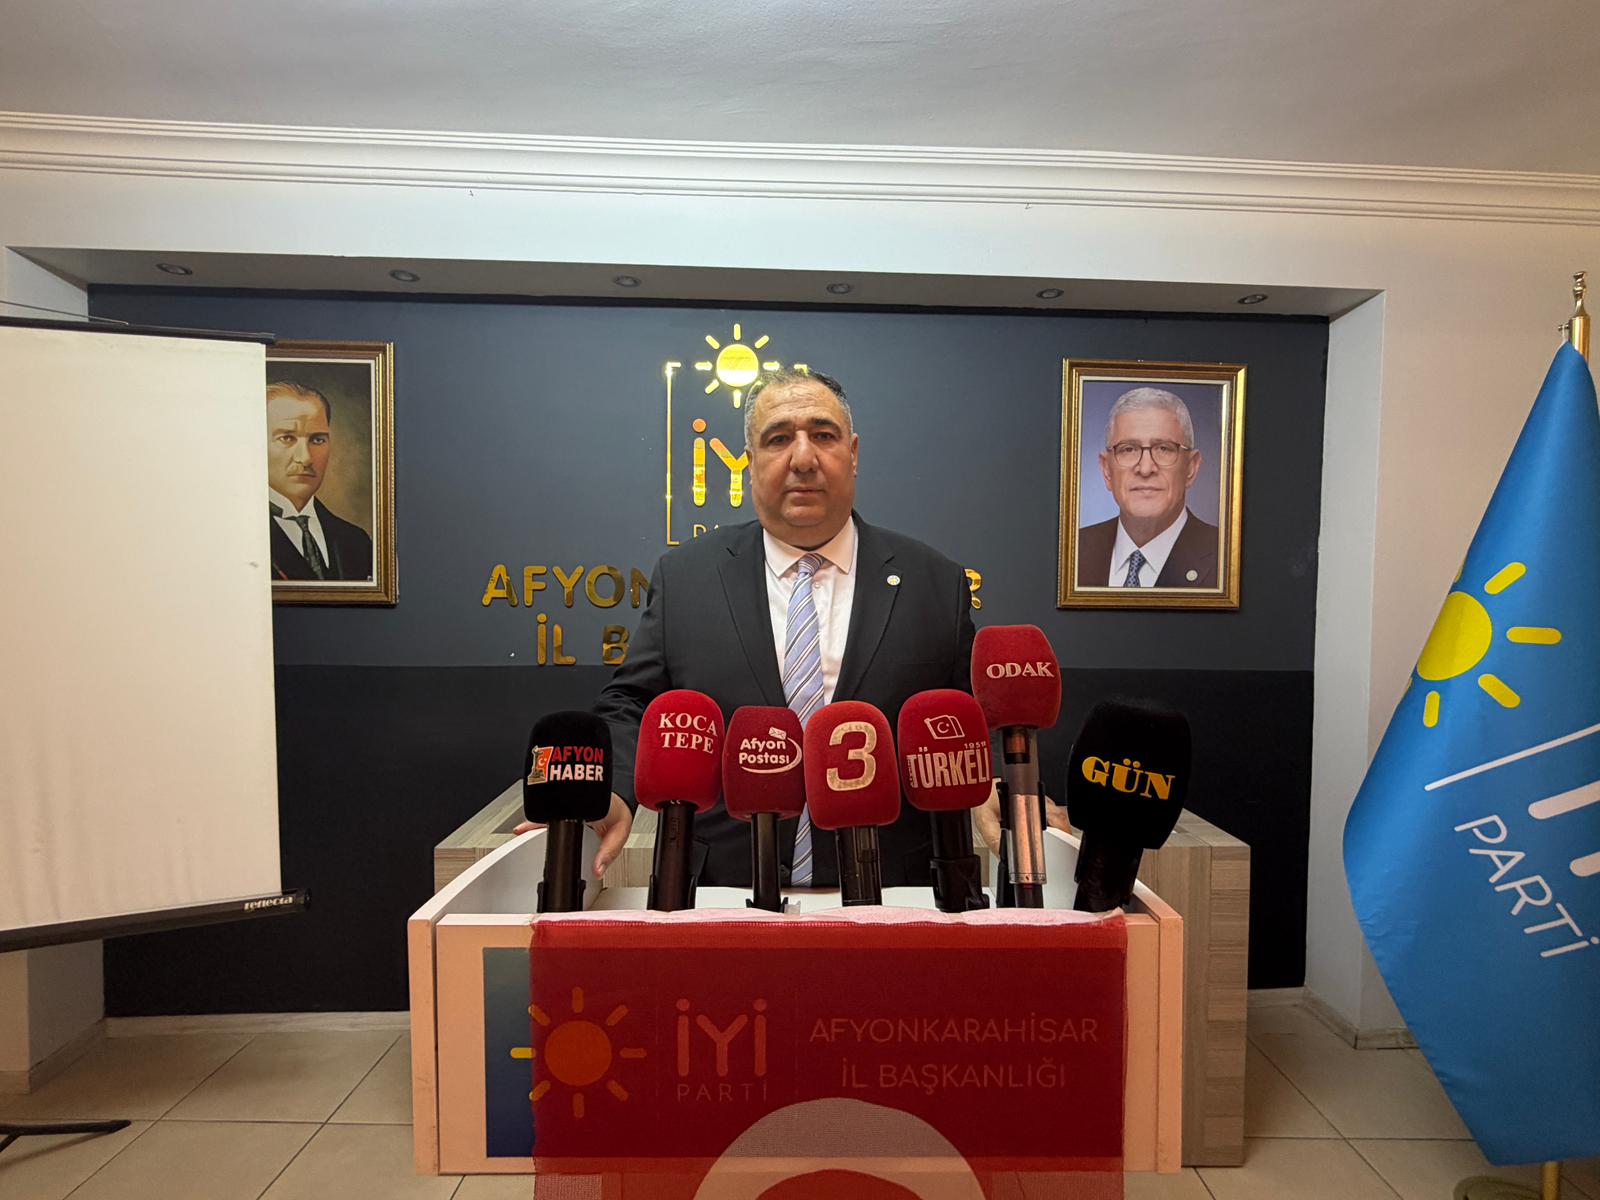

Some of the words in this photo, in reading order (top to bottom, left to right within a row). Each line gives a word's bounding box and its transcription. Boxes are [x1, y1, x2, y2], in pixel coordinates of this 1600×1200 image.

[692, 418, 750, 507] İY
[537, 613, 576, 665] İL
[986, 661, 1055, 680] ODAK
[658, 712, 718, 736] KOCA
[552, 746, 604, 763] AFYON
[661, 732, 715, 754] TEPE
[740, 738, 786, 753] Afyon
[738, 752, 790, 766] Postası
[826, 721, 878, 791] 3
[550, 764, 604, 782] HABER
[1081, 756, 1176, 800] GÜN
[1454, 815, 1600, 957] PARTİ
[244, 896, 293, 910] reflecta
[676, 998, 768, 1077] İYİ
[809, 1011, 1099, 1044] AFYONKARAHİSAR
[841, 1057, 867, 1088] İL
[878, 1057, 1066, 1095] BAŞKANLIĞI
[677, 1080, 769, 1102] PARTİ
